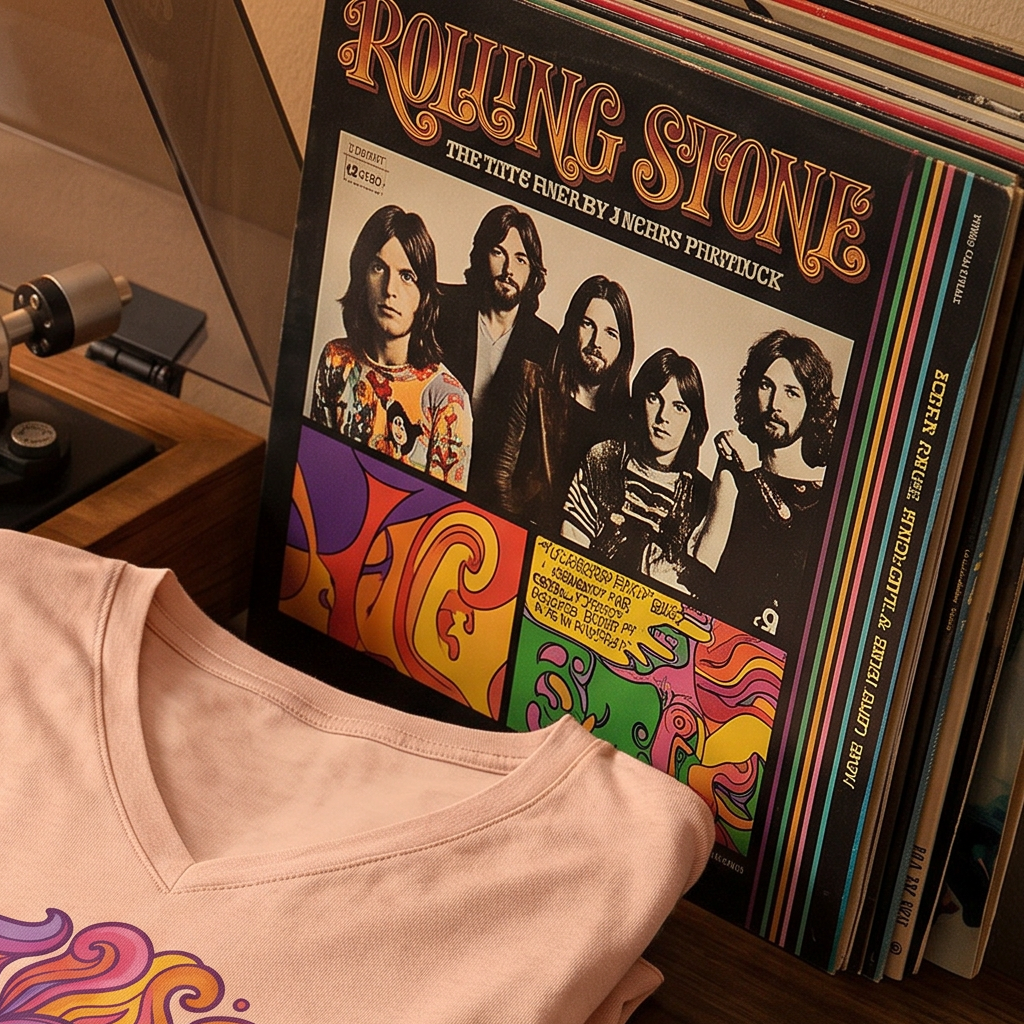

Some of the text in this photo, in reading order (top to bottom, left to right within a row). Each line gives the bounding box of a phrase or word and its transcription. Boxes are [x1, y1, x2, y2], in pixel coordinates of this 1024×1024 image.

[337, 0, 627, 186] ROLLING
[632, 103, 875, 285] STONE
[446, 139, 484, 170] THE
